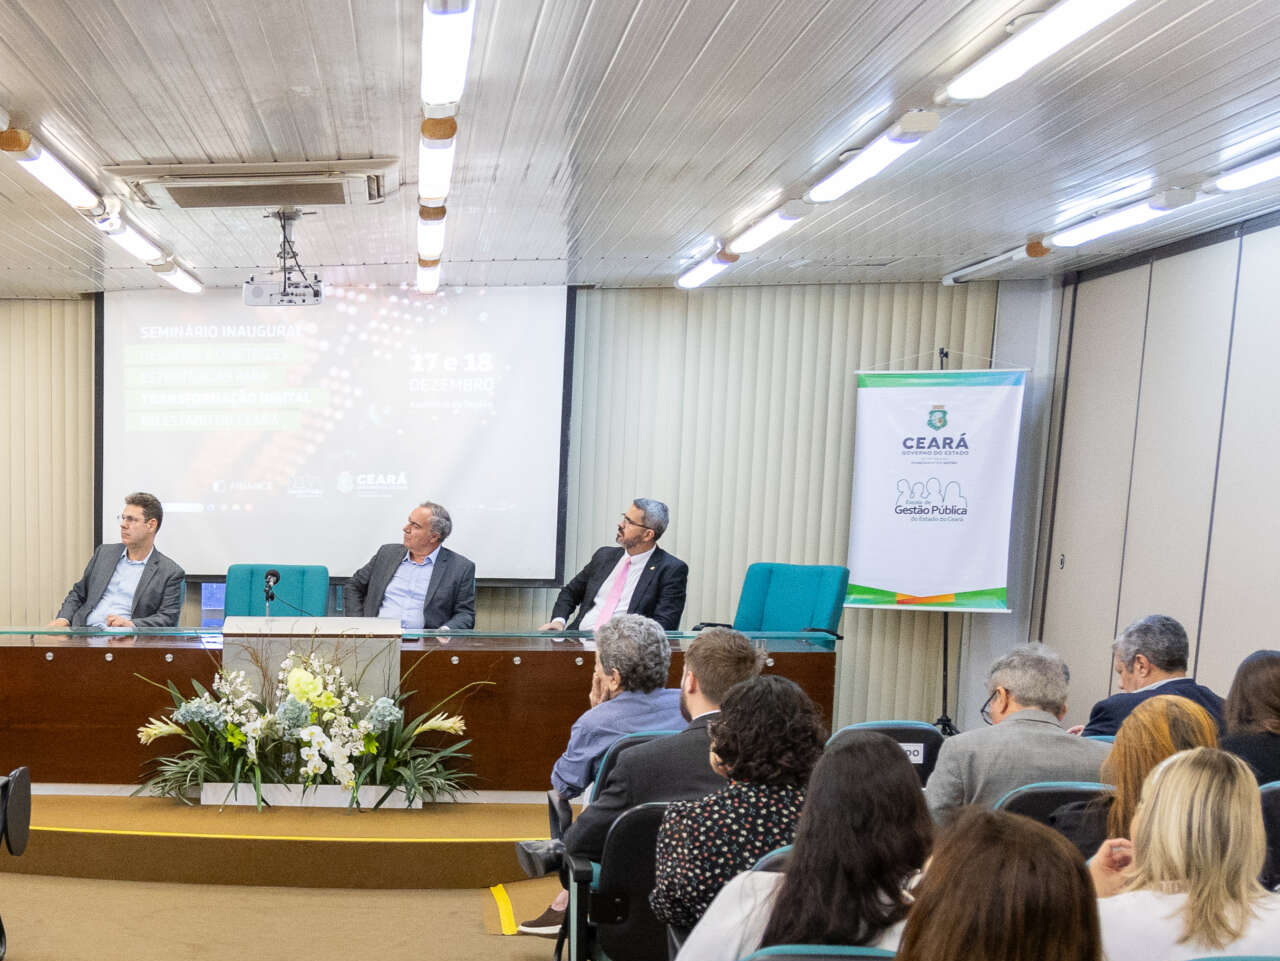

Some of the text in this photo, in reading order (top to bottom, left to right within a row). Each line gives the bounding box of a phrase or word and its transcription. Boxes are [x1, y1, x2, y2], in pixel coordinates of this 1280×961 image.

[140, 323, 218, 338] SEMINÁRIO
[408, 352, 495, 372] 17 e 18
[902, 432, 969, 450] CEARÁ
[357, 471, 408, 485] CEARÁ
[894, 504, 968, 515] Gestão Pública
